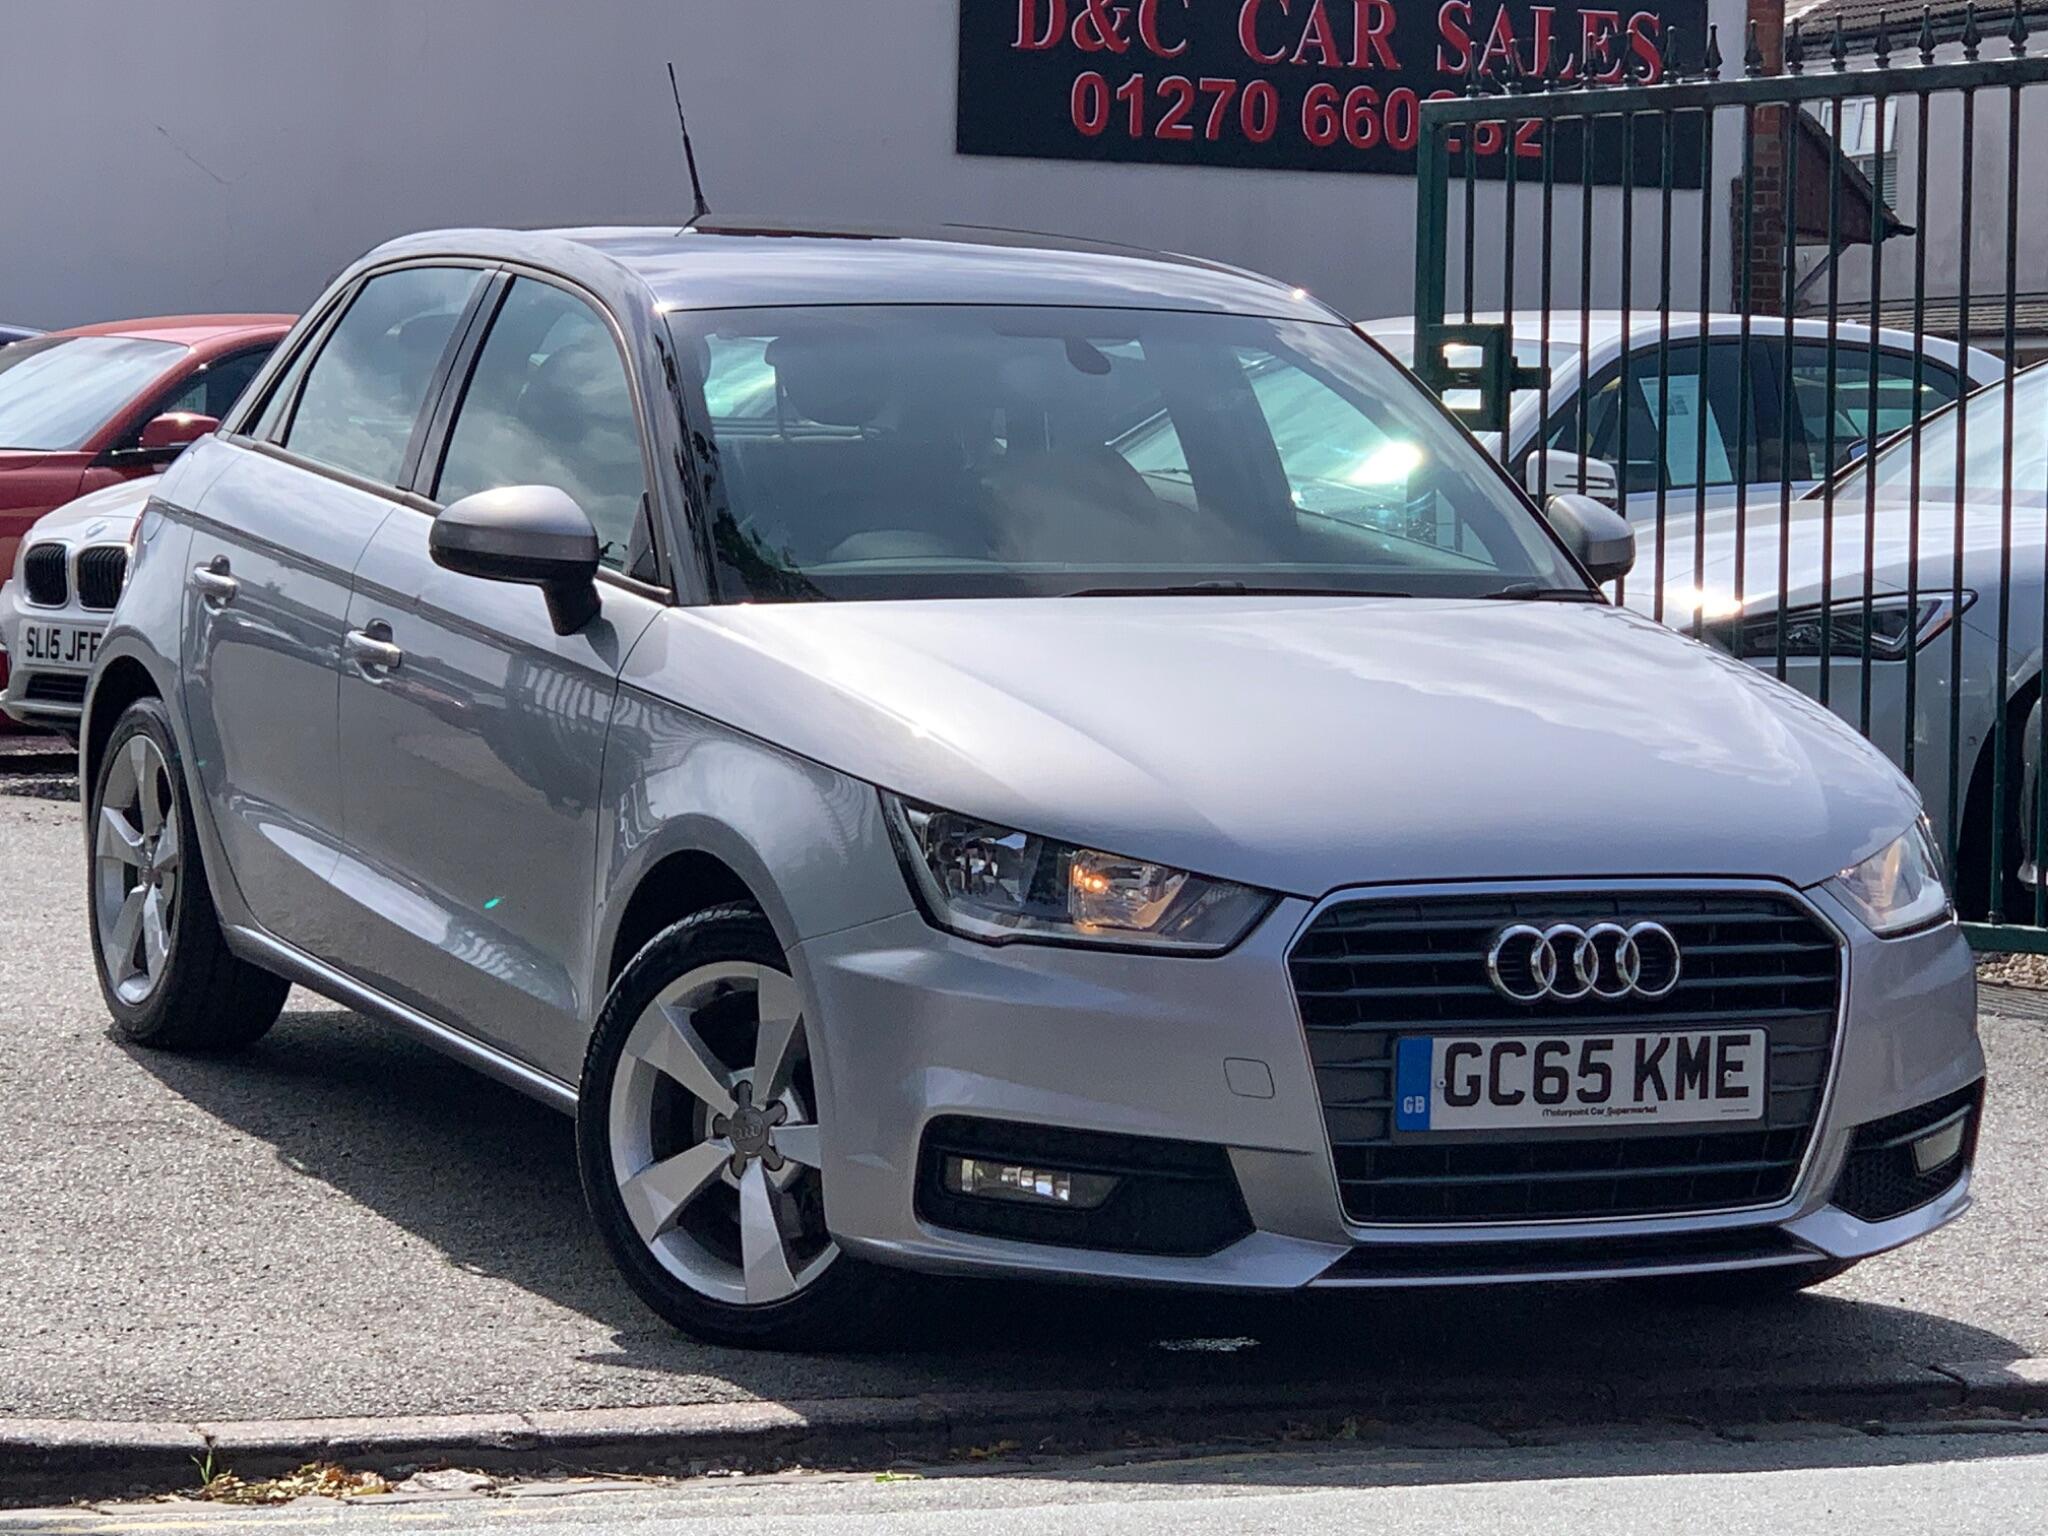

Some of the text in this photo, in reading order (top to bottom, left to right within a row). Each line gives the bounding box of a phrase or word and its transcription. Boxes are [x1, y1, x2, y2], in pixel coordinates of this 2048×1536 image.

[1011, 0, 1662, 86] D&C CAR SALES
[1071, 71, 1278, 142] 01270
[26, 626, 61, 660] SL15
[1403, 1095, 1425, 1114] GB
[1443, 1034, 1752, 1107] GC65 KME
